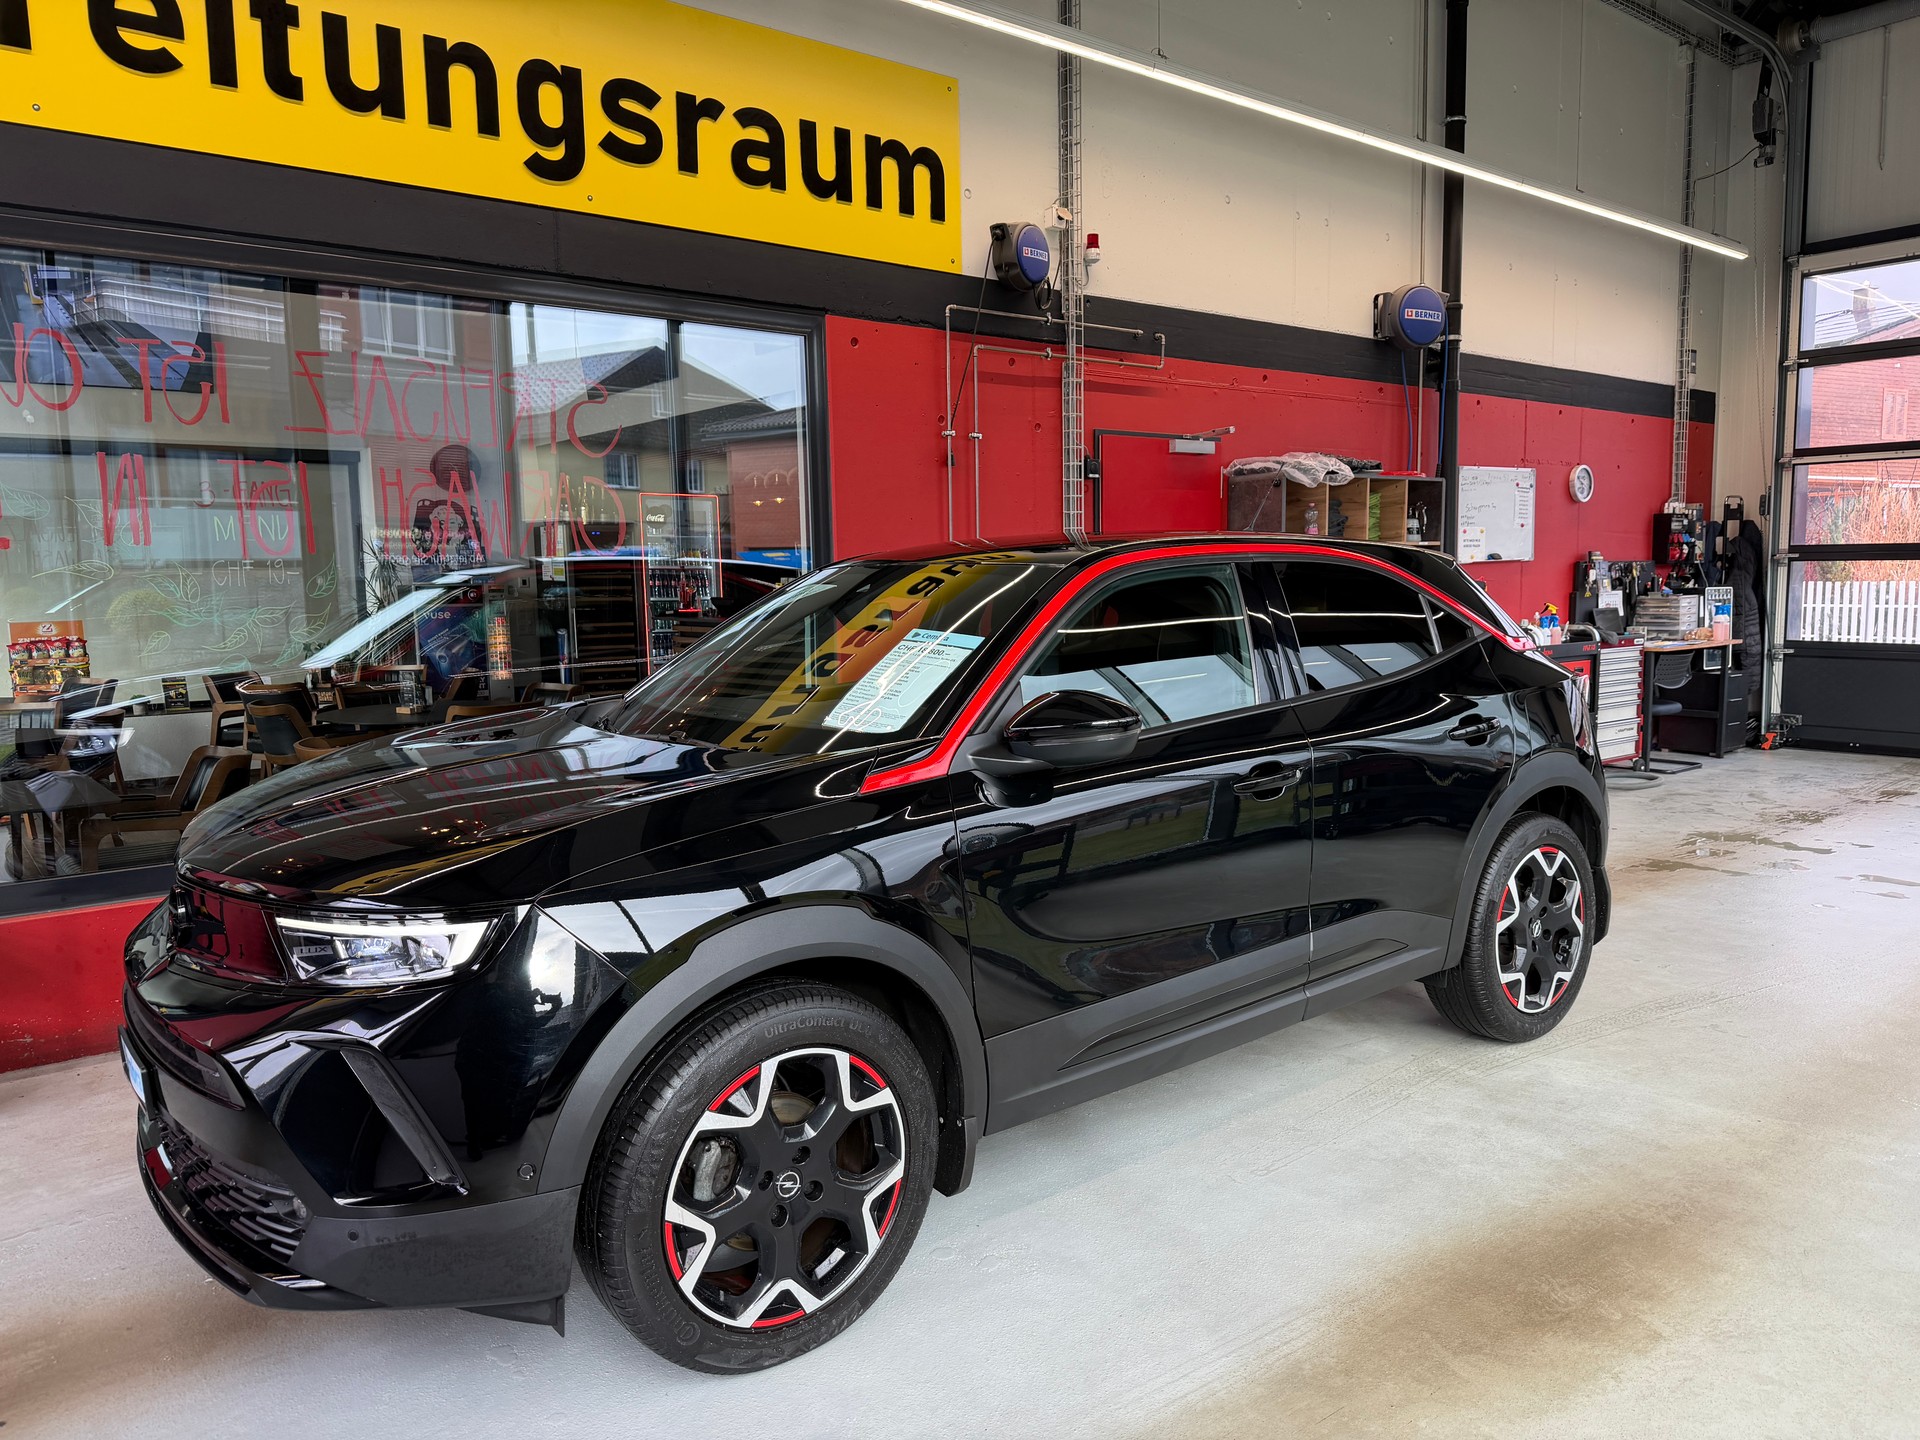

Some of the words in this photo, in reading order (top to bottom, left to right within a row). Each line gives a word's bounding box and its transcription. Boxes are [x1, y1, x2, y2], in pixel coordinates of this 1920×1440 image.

[1030, 249, 1048, 260] BERNER
[1414, 310, 1441, 320] BERNER
[212, 558, 254, 587] CHF
